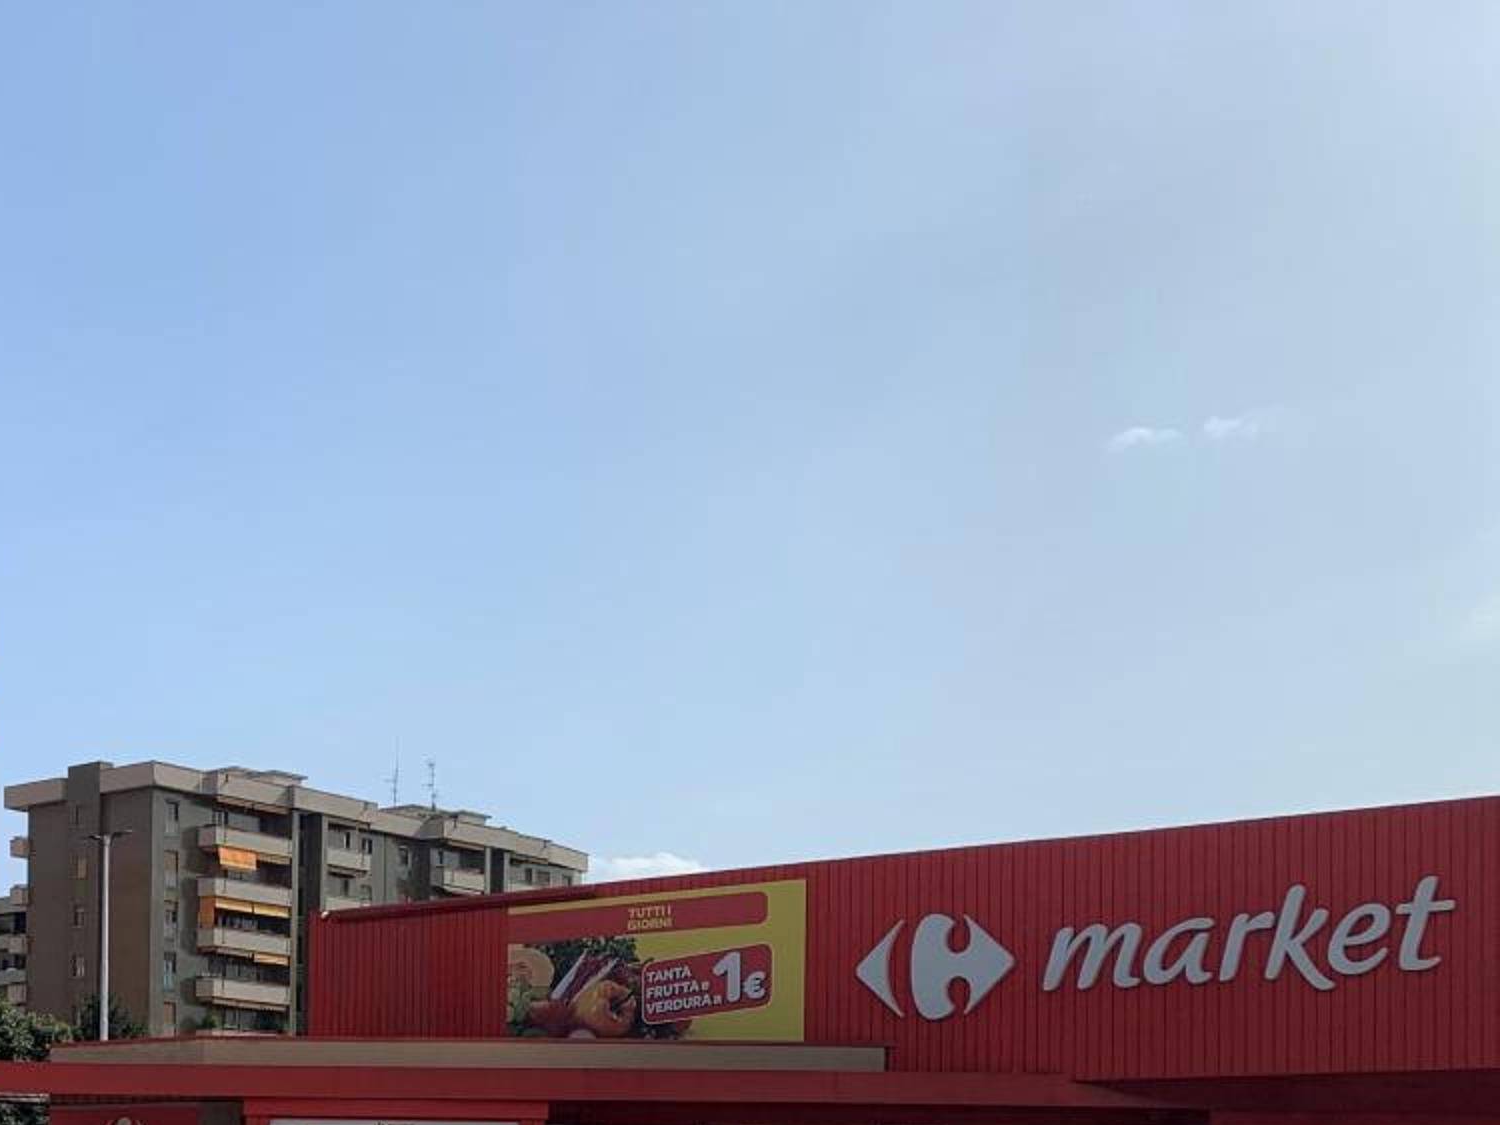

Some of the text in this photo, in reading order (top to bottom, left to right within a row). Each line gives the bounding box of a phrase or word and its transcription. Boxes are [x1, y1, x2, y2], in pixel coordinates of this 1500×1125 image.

[628, 906, 665, 918] TUTTI
[1042, 875, 1456, 991] market
[647, 965, 692, 983] TANTA
[646, 981, 699, 998] FRUTTA
[646, 993, 712, 1014] VERDURA
